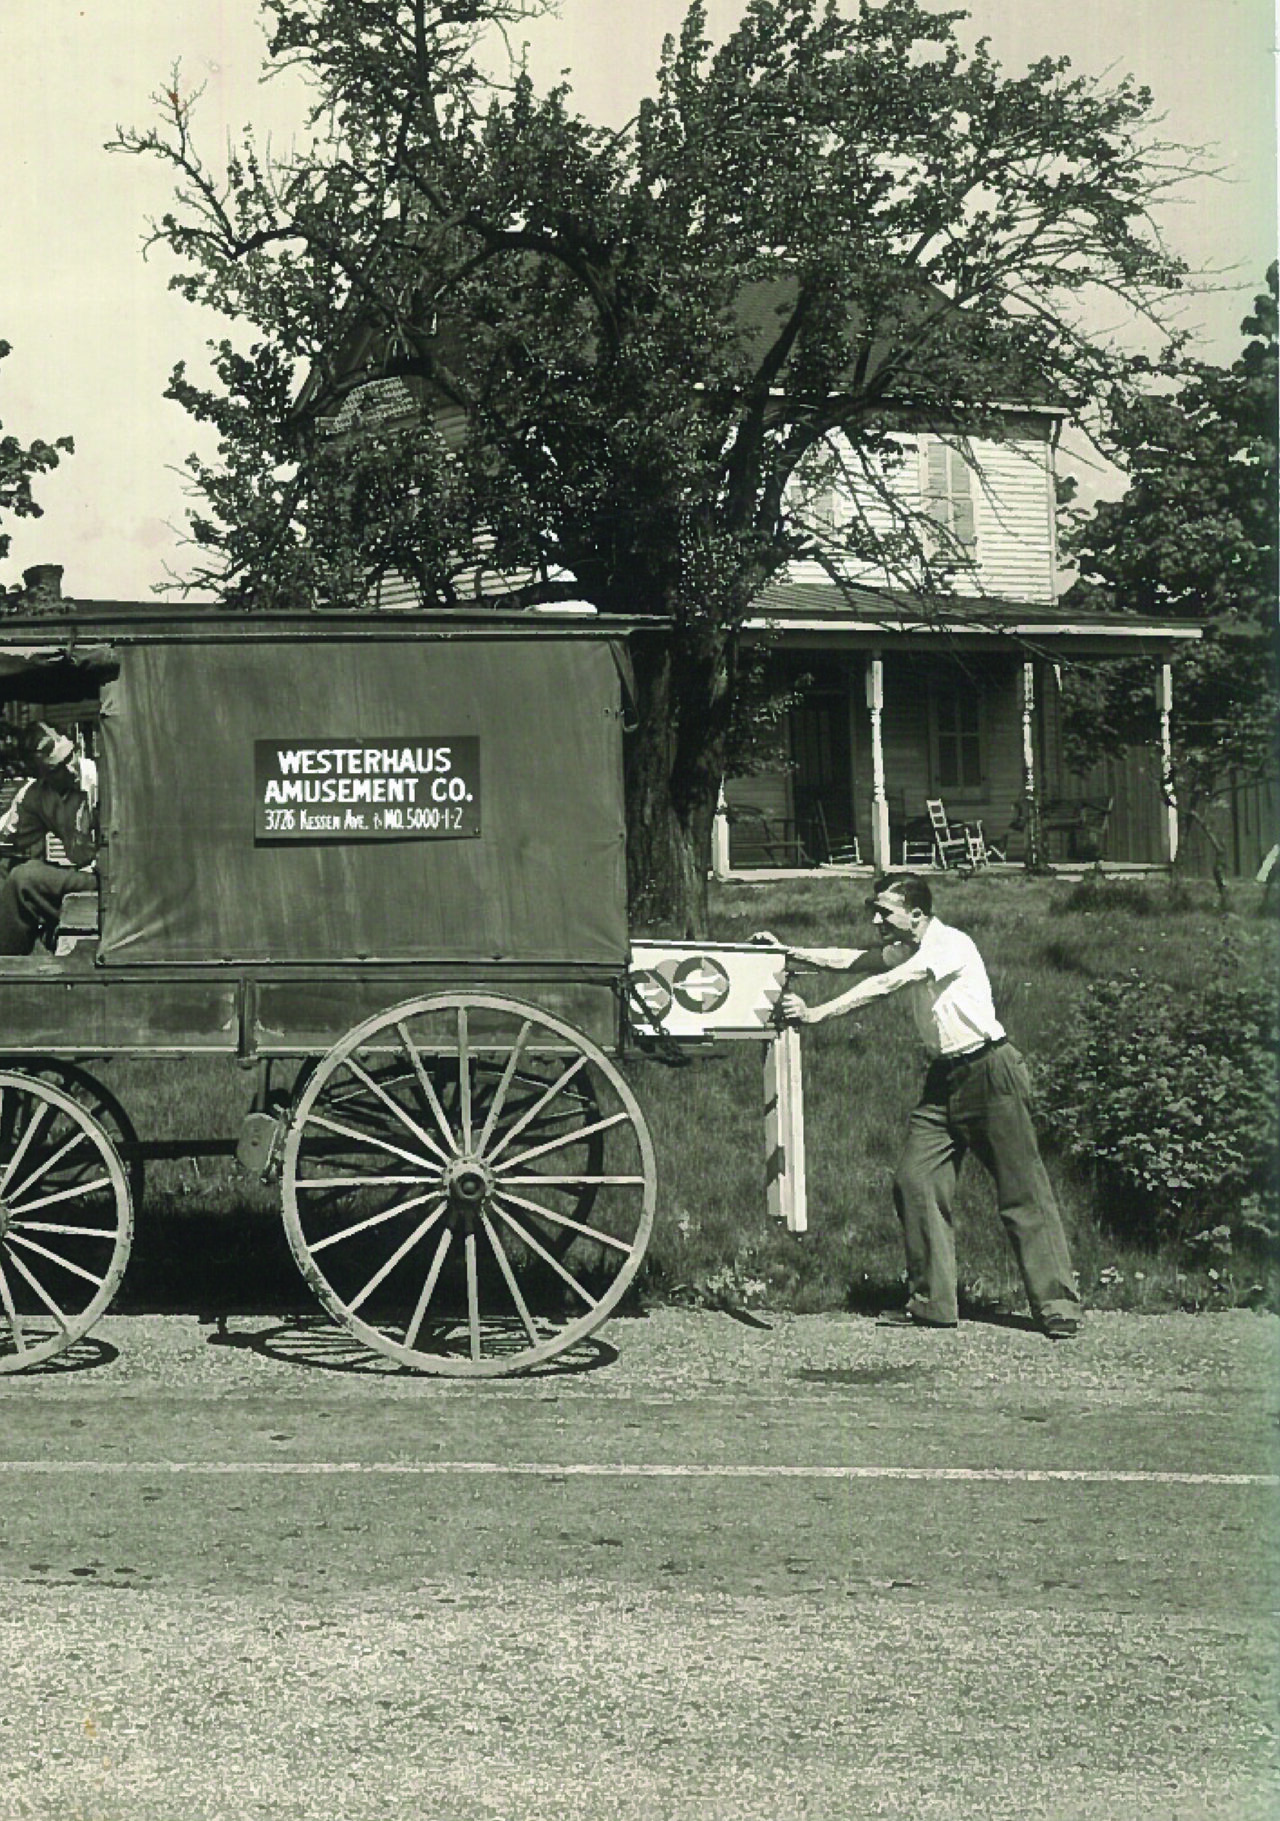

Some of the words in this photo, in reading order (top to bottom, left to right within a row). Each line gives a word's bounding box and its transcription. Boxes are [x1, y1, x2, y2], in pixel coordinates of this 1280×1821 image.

[277, 747, 452, 775] WESTERHAUS
[263, 777, 419, 805] AMUSEMENT
[430, 777, 474, 803] CO.
[264, 808, 296, 831] 3726
